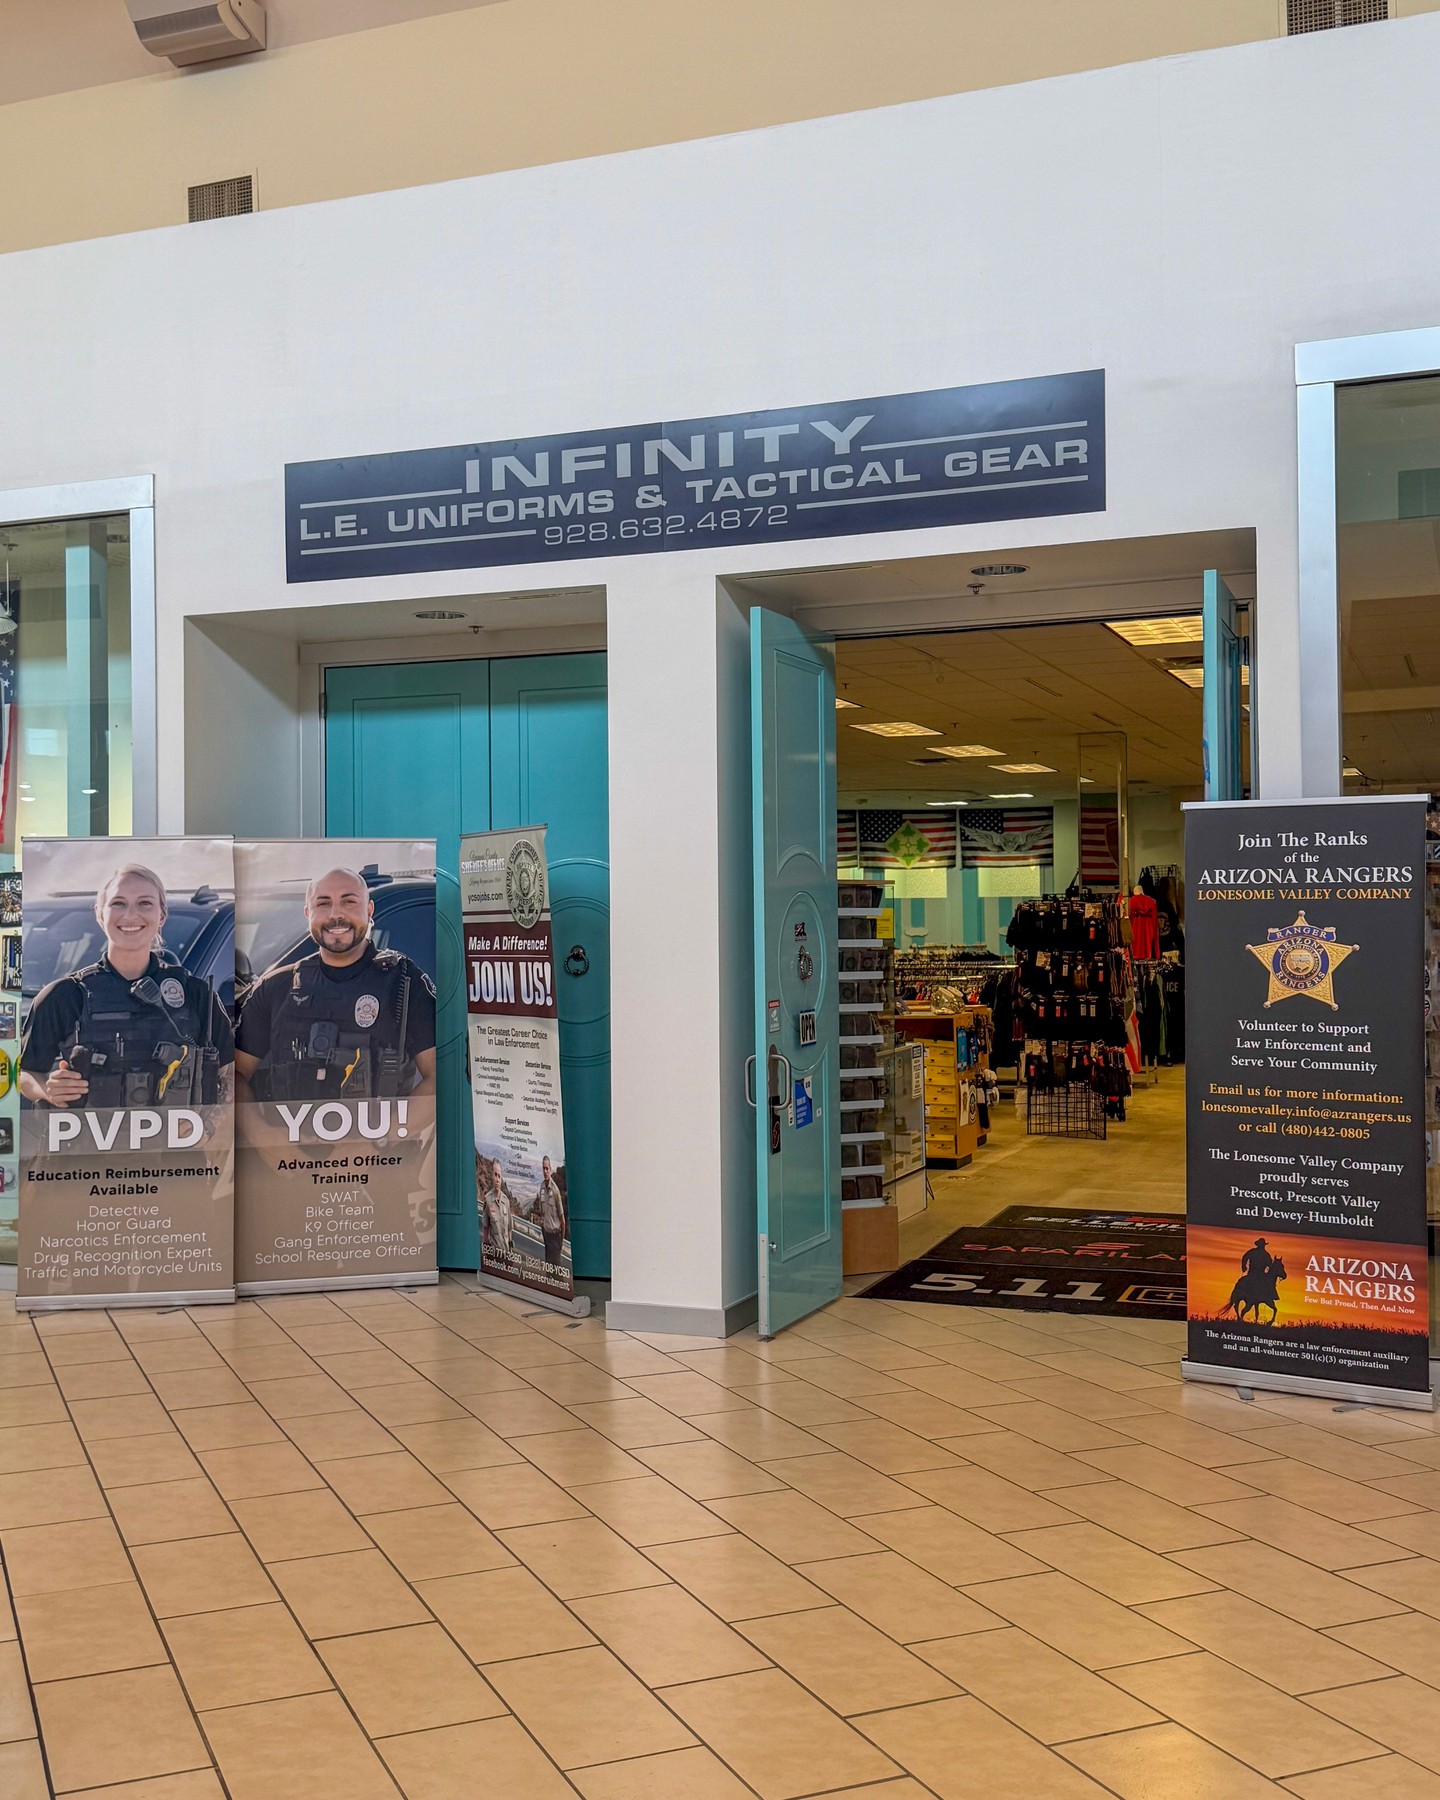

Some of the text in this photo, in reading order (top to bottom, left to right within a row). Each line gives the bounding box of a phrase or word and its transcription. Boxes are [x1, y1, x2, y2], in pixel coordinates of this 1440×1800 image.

[465, 414, 875, 494] INFINITY
[300, 438, 1088, 541] L.E. UNIFORMS & TACTICAL GEAR
[544, 505, 788, 545] 928.632.4872
[1238, 831, 1368, 851] Join The Ranks
[1284, 852, 1320, 863] of the
[1198, 866, 1413, 885] ARIZONA RANGERS
[1197, 888, 1413, 900] LONESOME VALLEY COMPANY
[468, 935, 548, 950] Make A Difference!
[1276, 927, 1327, 939] RANGER
[1277, 938, 1325, 955] ARIZONA
[469, 961, 552, 1006] JOIN US!
[1166, 981, 1178, 992] ICE
[1275, 970, 1326, 989] RANGERS
[801, 1013, 816, 1042] OPEN
[1238, 1020, 1369, 1036] Volunteer to Support
[1236, 1038, 1371, 1053] Law Enforcement and
[1231, 1056, 1378, 1075] Serve Your Community
[1209, 1083, 1403, 1104] Email us for more information:
[275, 1099, 409, 1143] YOU!
[1201, 1100, 1412, 1124] lonesomevalley.info@azrangers.us
[48, 1108, 204, 1152] PVPD
[1238, 1121, 1370, 1140] or call (480)442-0805
[277, 1153, 402, 1172] Advanced Officer
[1208, 1148, 1404, 1176] The Lonesome Valley Company
[27, 1166, 220, 1182] Education Reimbursement
[312, 1171, 369, 1185] Training
[1259, 1171, 1349, 1188] proudly serves
[89, 1183, 159, 1197] Available
[321, 1190, 360, 1203] SWAT
[1230, 1186, 1381, 1211] Prescott, Prescott Valley
[88, 1204, 159, 1218] Detective
[305, 1203, 374, 1218] Bike Team
[1236, 1205, 1374, 1227] and Dewey-Humboldt
[76, 1217, 171, 1232] Honor Guard
[305, 1218, 374, 1233] K9 Officer
[40, 1231, 207, 1248] Narcotics Enforcement
[274, 1231, 405, 1252] Gang Enforcement
[34, 1246, 212, 1266] Drug Recognition Expert
[255, 1243, 423, 1265] School Resource Officer
[24, 1260, 223, 1280] Traffic and Motorcycle Units
[1304, 1255, 1415, 1282] ARIZONA
[910, 1273, 1105, 1301] 5.11
[1304, 1275, 1415, 1303] RANGERS
[1304, 1295, 1415, 1314] Few But Proud, Then And Now
[1205, 1329, 1219, 1339] The
[1221, 1331, 1251, 1342] Arizona
[1253, 1335, 1284, 1347] Rangers
[1286, 1340, 1298, 1348] are
[1306, 1341, 1320, 1351] law
[1322, 1344, 1371, 1357] enforcement
[1373, 1350, 1410, 1364] auxiliary
[1223, 1342, 1237, 1351] and
[1250, 1345, 1299, 1360] all-volunteer
[1301, 1351, 1337, 1364] 501(c)(3)
[1338, 1356, 1389, 1370] organization
